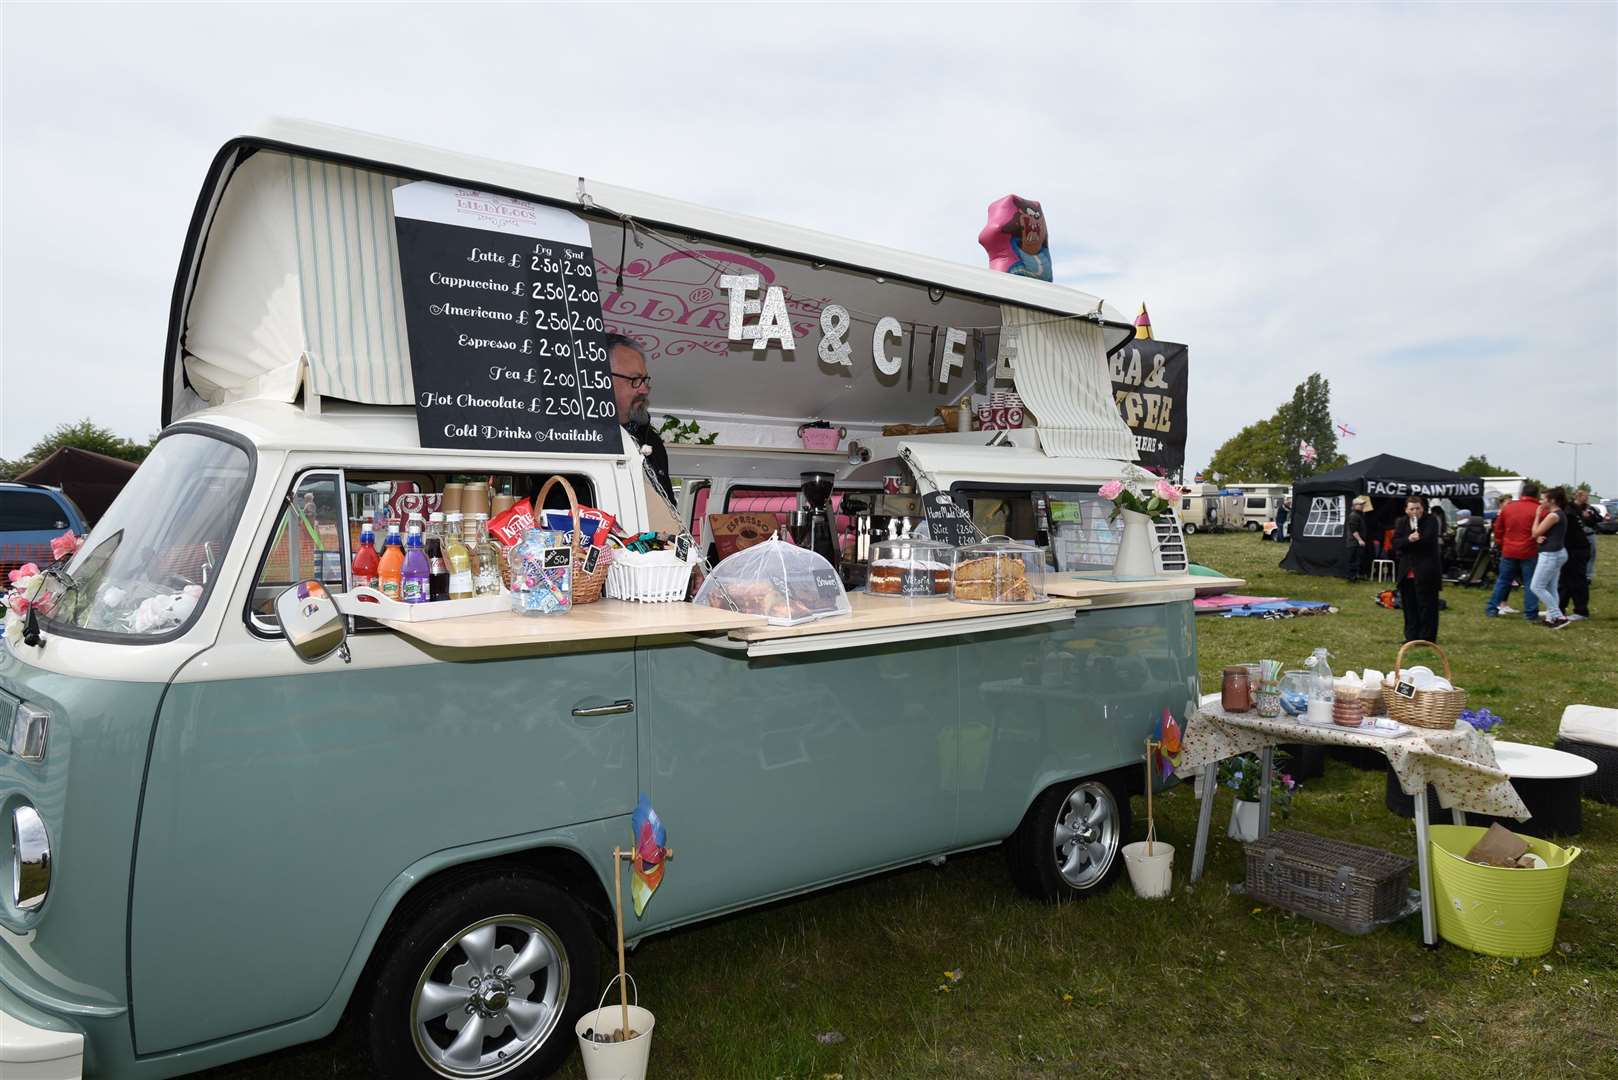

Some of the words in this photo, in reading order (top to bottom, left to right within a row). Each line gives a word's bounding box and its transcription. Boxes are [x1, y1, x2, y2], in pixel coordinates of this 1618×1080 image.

[467, 248, 505, 264] Latte
[508, 253, 521, 268] £
[531, 256, 559, 273] 2.50
[563, 261, 593, 278] 2.00
[533, 243, 552, 256] Lrg
[429, 272, 509, 293] Cappuccino
[512, 282, 525, 296] £
[532, 282, 564, 301] 2.50
[567, 284, 599, 303] 2.00
[429, 303, 513, 321] Americano
[515, 310, 529, 326] £
[535, 309, 569, 331] 2.50
[571, 311, 604, 332] 2.00
[720, 274, 796, 350] TEA
[818, 305, 853, 366] &
[458, 334, 517, 350] Espresso
[519, 339, 533, 354] £
[540, 339, 570, 357] 2.00
[574, 339, 607, 362] 1.50
[489, 366, 520, 381] Tea
[523, 369, 537, 383] £
[543, 369, 575, 387] 2.00
[580, 369, 612, 389] 1.50
[1144, 353, 1169, 389] &
[419, 391, 452, 408] Hot
[456, 394, 525, 410] Chocolate
[527, 398, 541, 413] £
[545, 398, 581, 416] 2.50
[586, 397, 616, 418] 2.00
[444, 424, 477, 439] Cold
[481, 425, 532, 440] Drinks
[535, 428, 604, 442] Available
[1367, 481, 1407, 495] FACE
[1411, 482, 1480, 497] PAINTING
[727, 515, 769, 532] ESPRESSO
